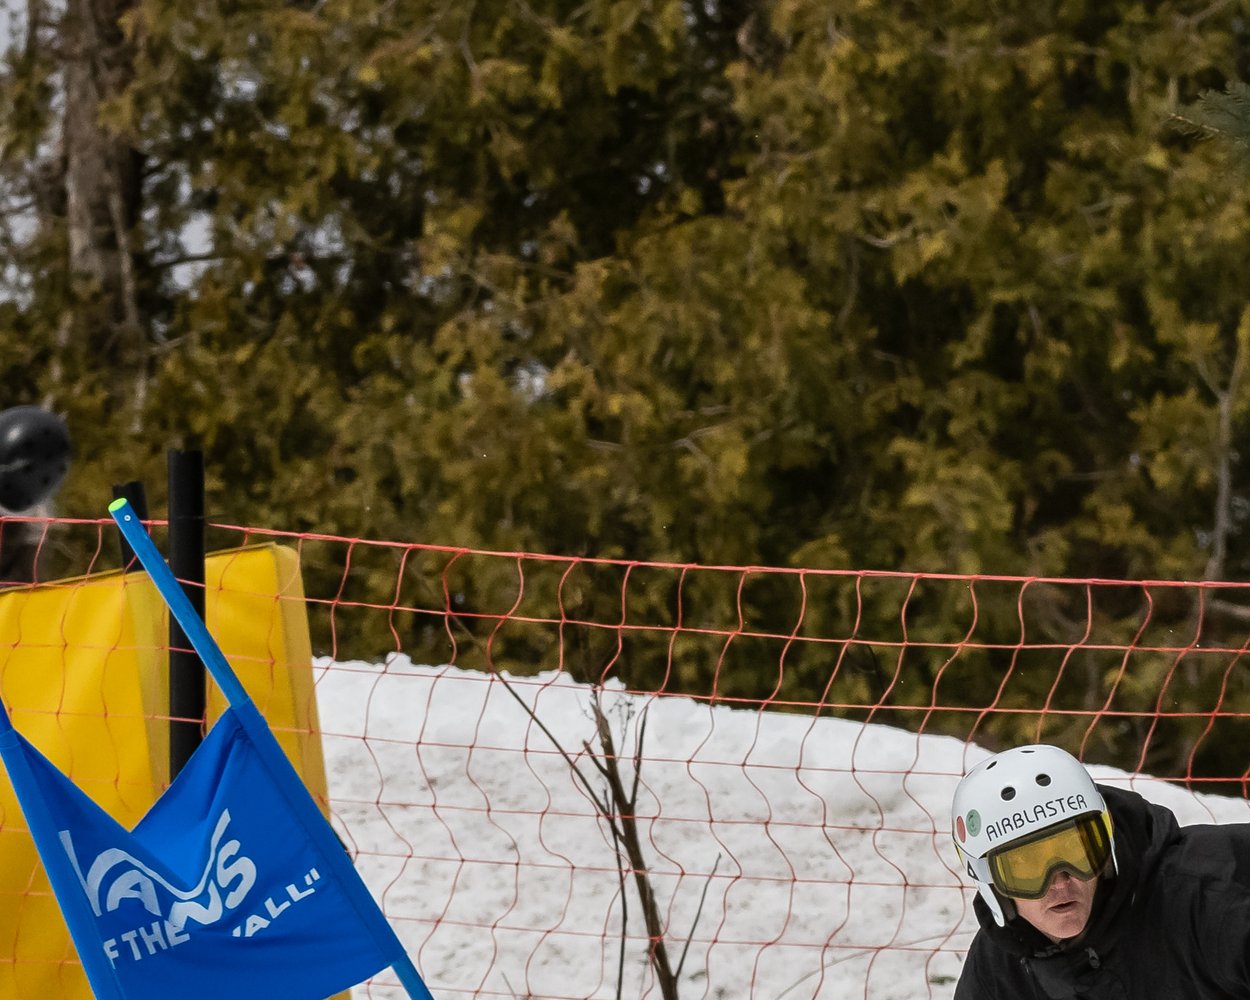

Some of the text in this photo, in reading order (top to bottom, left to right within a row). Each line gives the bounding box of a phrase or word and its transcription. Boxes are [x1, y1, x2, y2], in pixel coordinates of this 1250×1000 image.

[985, 793, 1088, 842] AIRBLASTER
[120, 919, 192, 961] THE
[231, 867, 321, 938] ALL"
